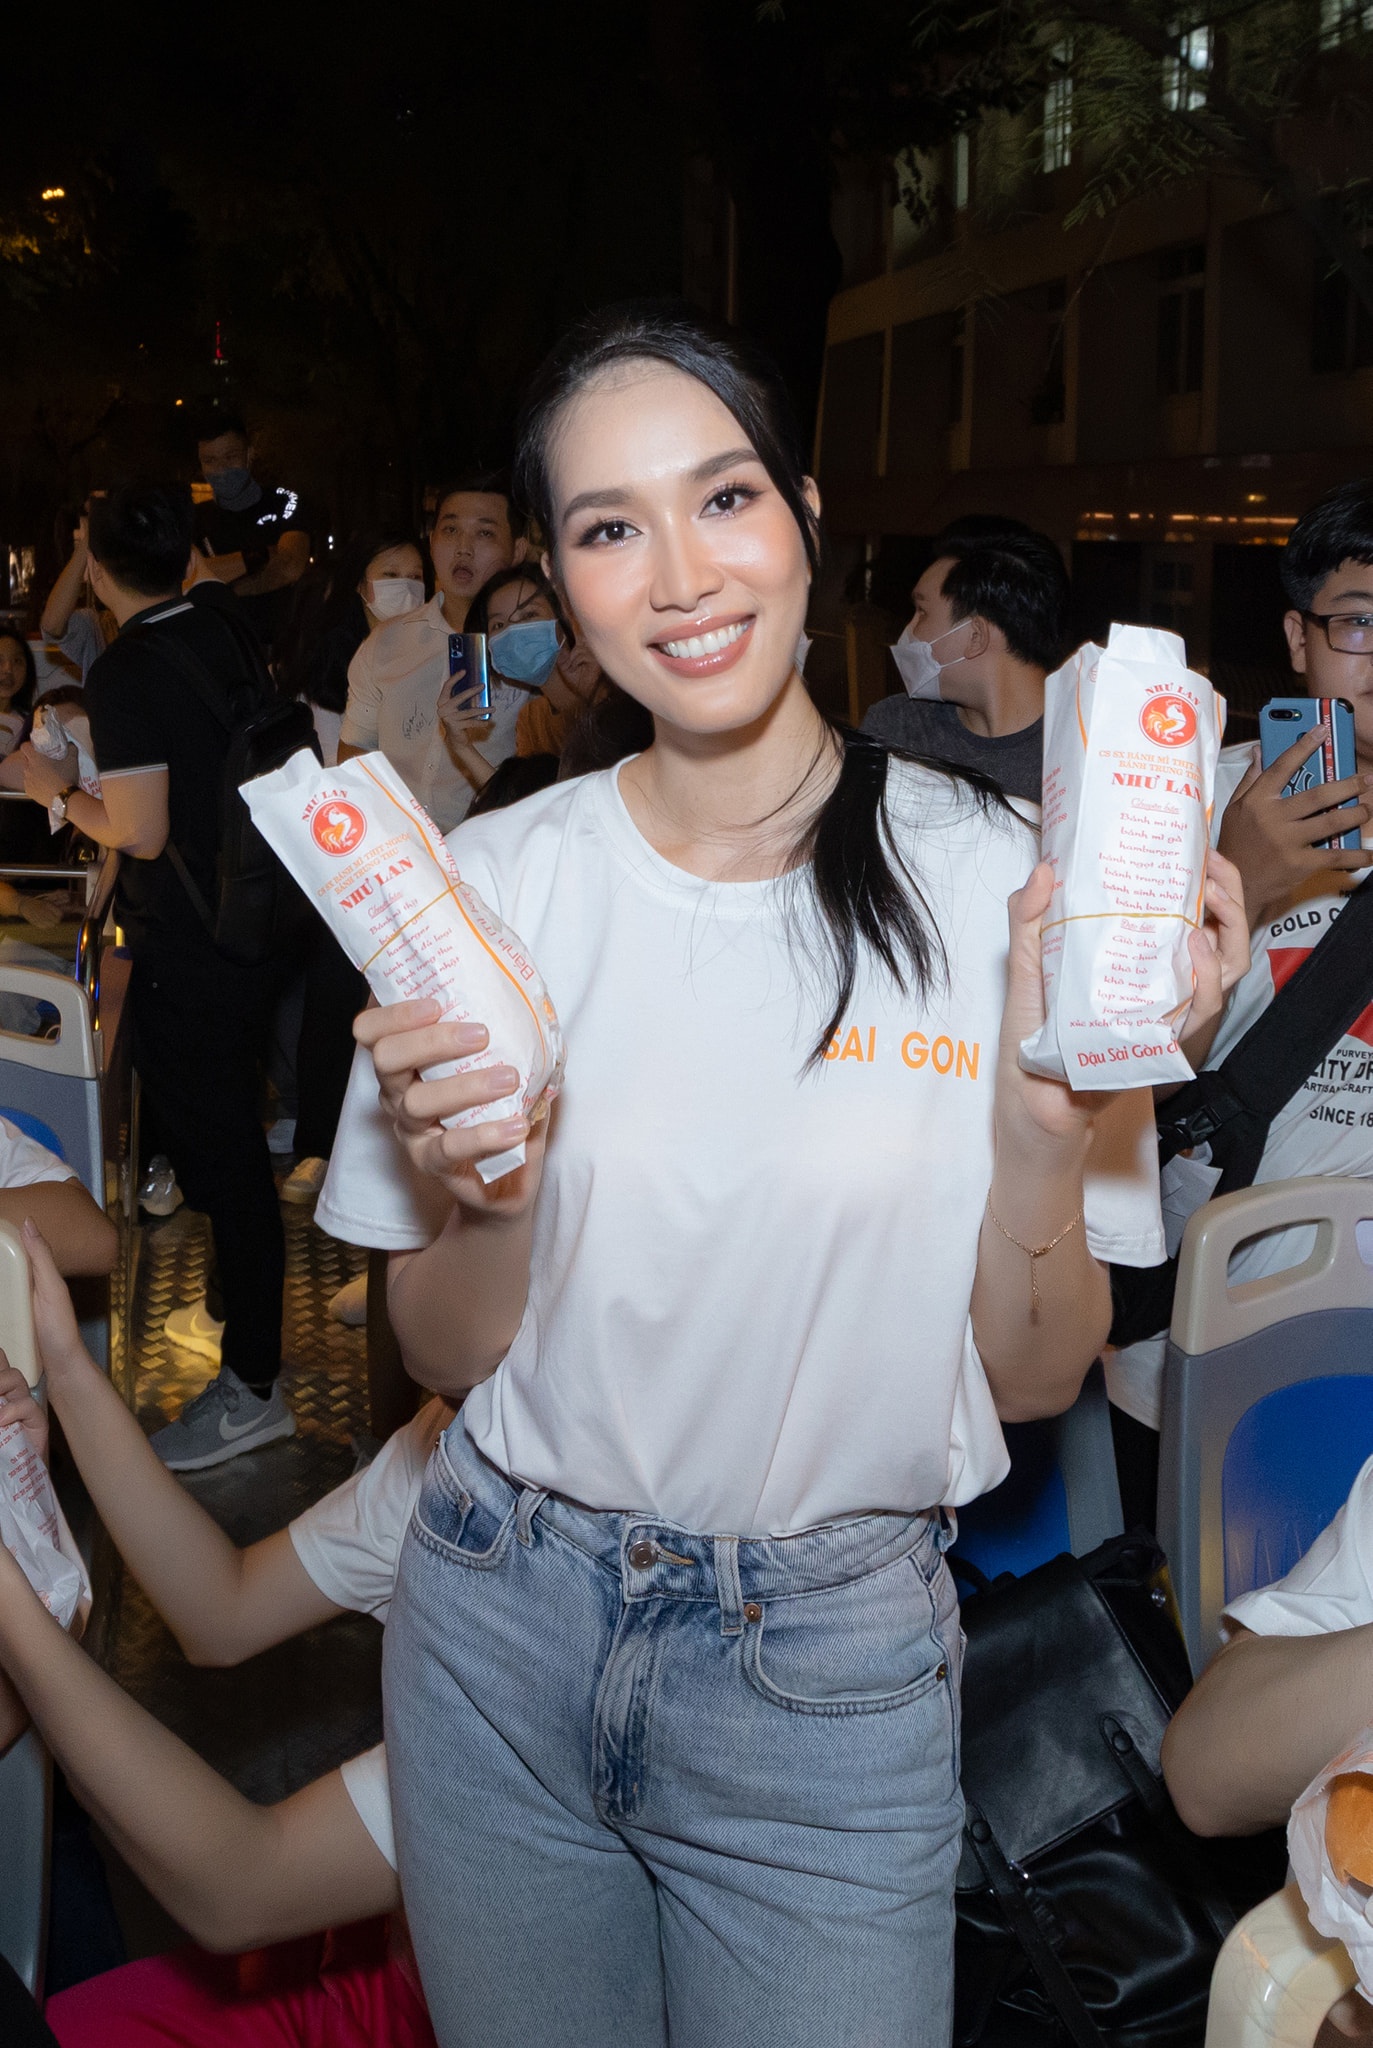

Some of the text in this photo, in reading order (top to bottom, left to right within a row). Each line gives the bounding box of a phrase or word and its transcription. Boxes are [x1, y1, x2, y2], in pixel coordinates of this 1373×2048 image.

[1111, 772, 1160, 790] NHƯ
[321, 789, 348, 800] LAN
[1119, 841, 1181, 857] hamburger
[338, 856, 415, 914] NHƯ LAN
[1270, 910, 1322, 938] GOLD
[901, 1030, 982, 1081] GON
[1108, 1045, 1131, 1063] Sài
[1132, 1041, 1164, 1060] Gòn
[1309, 1104, 1356, 1127] SINCE
